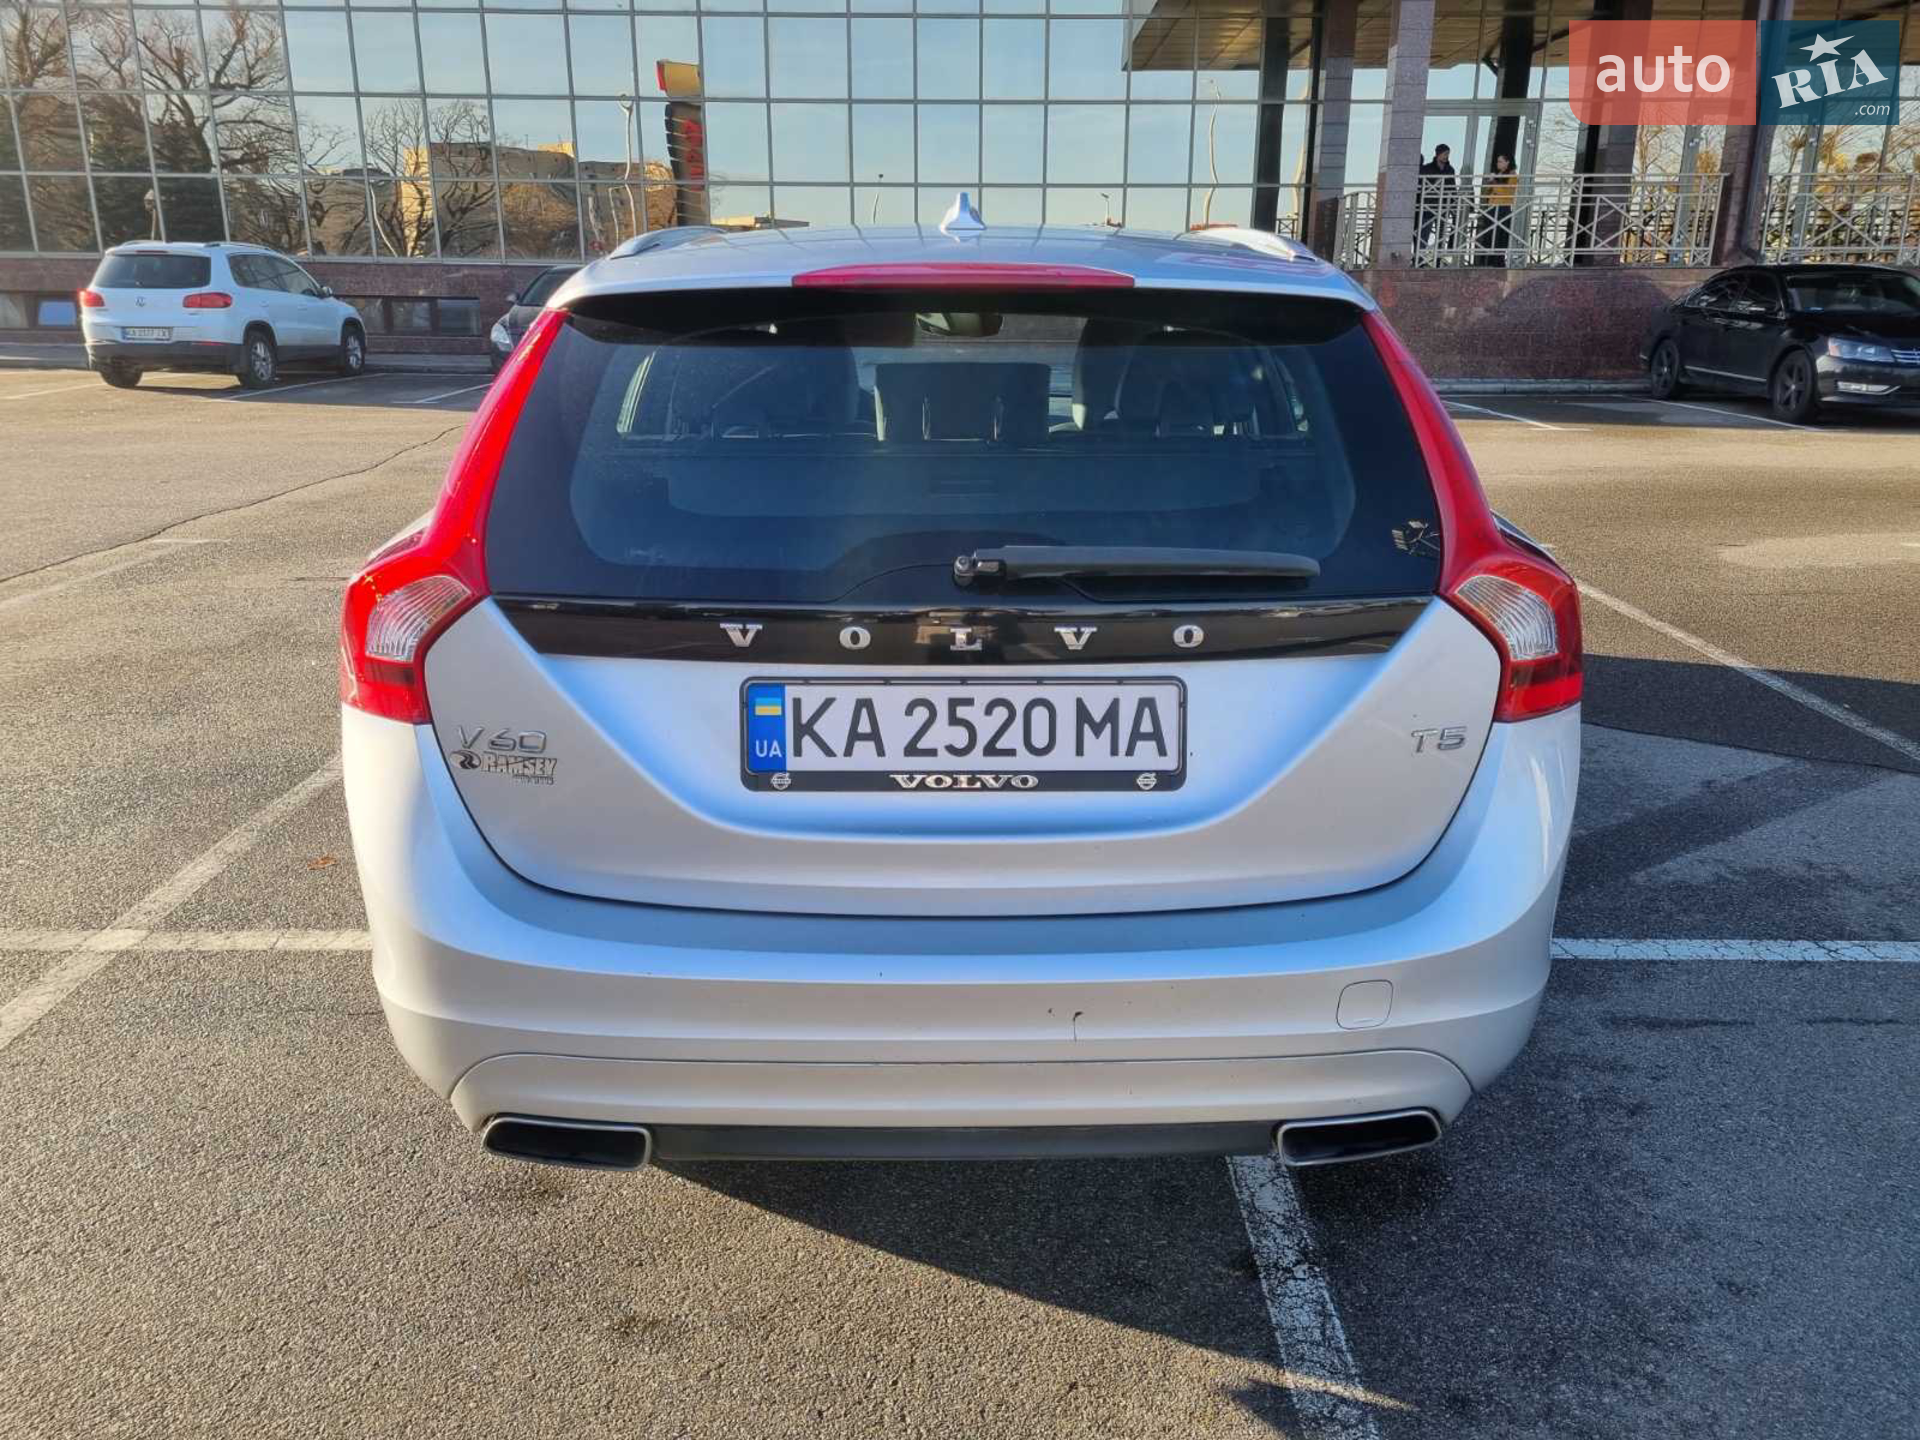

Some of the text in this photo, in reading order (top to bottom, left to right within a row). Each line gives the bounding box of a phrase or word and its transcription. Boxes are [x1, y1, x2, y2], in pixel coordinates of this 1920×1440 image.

[719, 623, 1205, 651] VOLVO
[459, 726, 547, 754] V60
[792, 697, 1168, 758] KA 2520 MA
[1411, 726, 1467, 753] T5
[754, 740, 783, 758] UA
[482, 751, 557, 775] RAMSEY
[889, 774, 1039, 789] VOLVO
